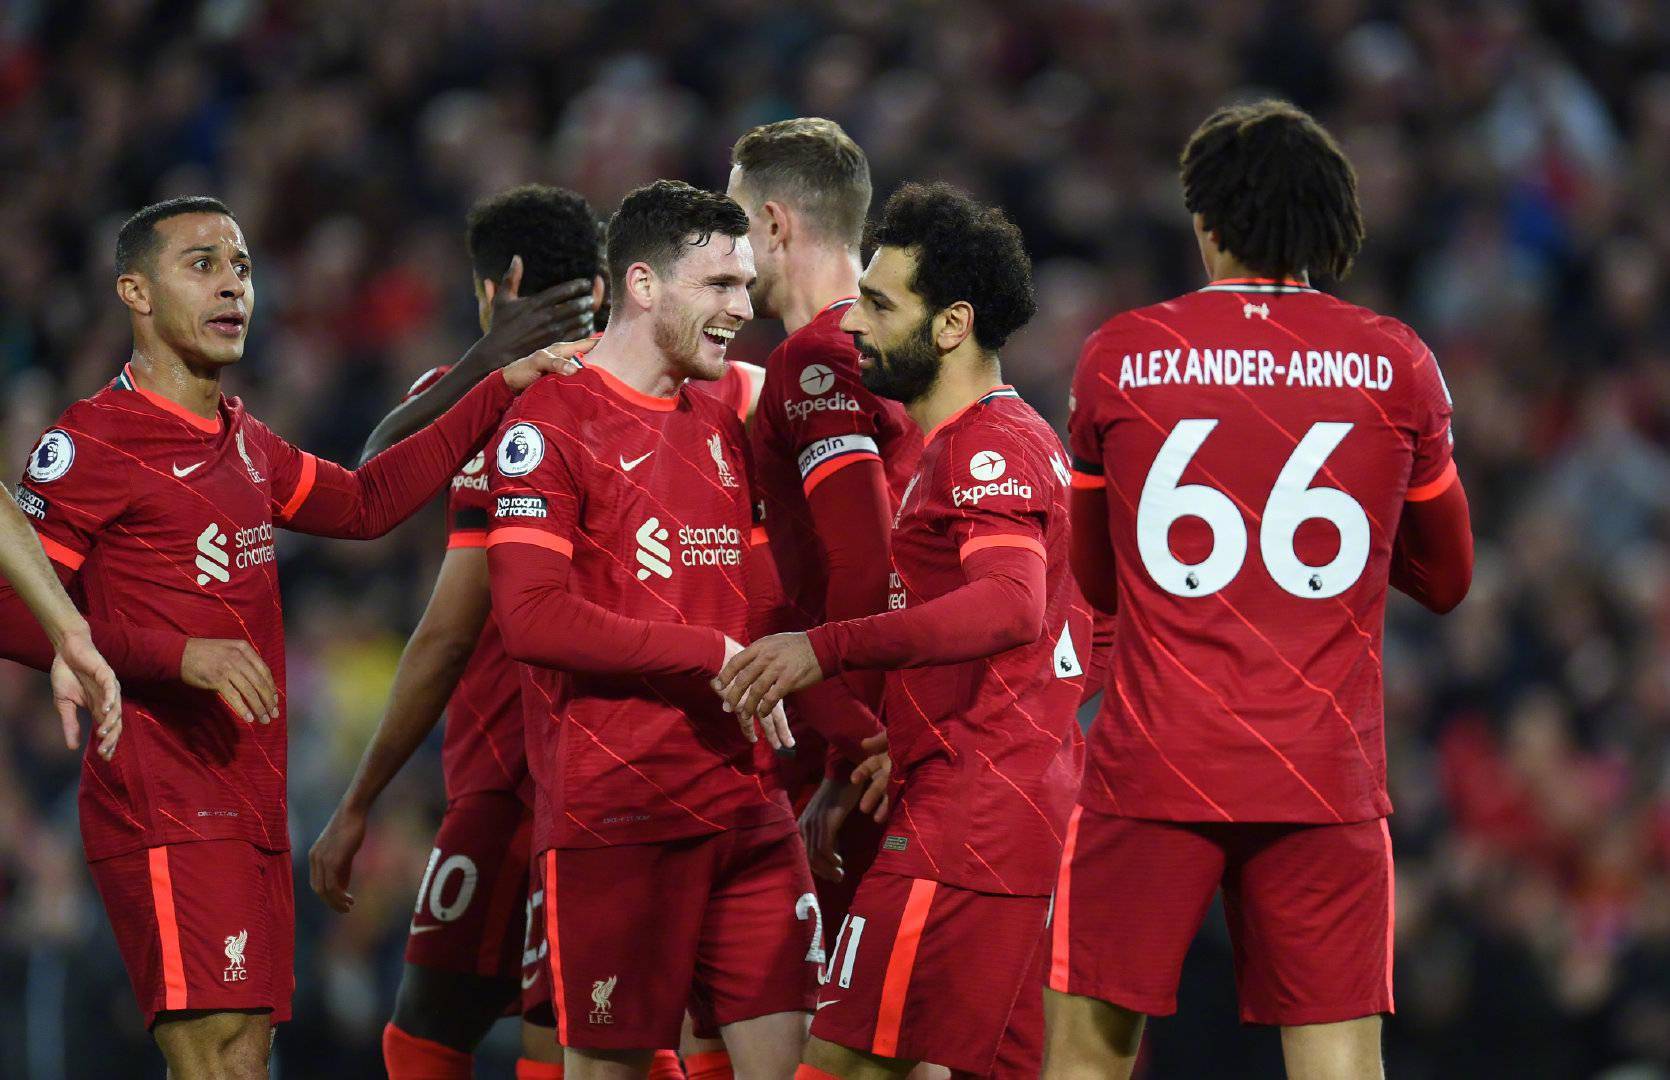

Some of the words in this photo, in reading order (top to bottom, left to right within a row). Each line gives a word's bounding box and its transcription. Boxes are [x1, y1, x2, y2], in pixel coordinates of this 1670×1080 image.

[1119, 347, 1394, 393] ALEXANDER-ARNOLD
[784, 392, 861, 420] Expedia
[497, 497, 510, 508] No
[511, 496, 542, 507] room
[952, 478, 1032, 507] Expedia
[495, 506, 509, 517] for
[509, 506, 547, 518] racism
[1136, 418, 1371, 600] 66
[413, 847, 478, 922] 10
